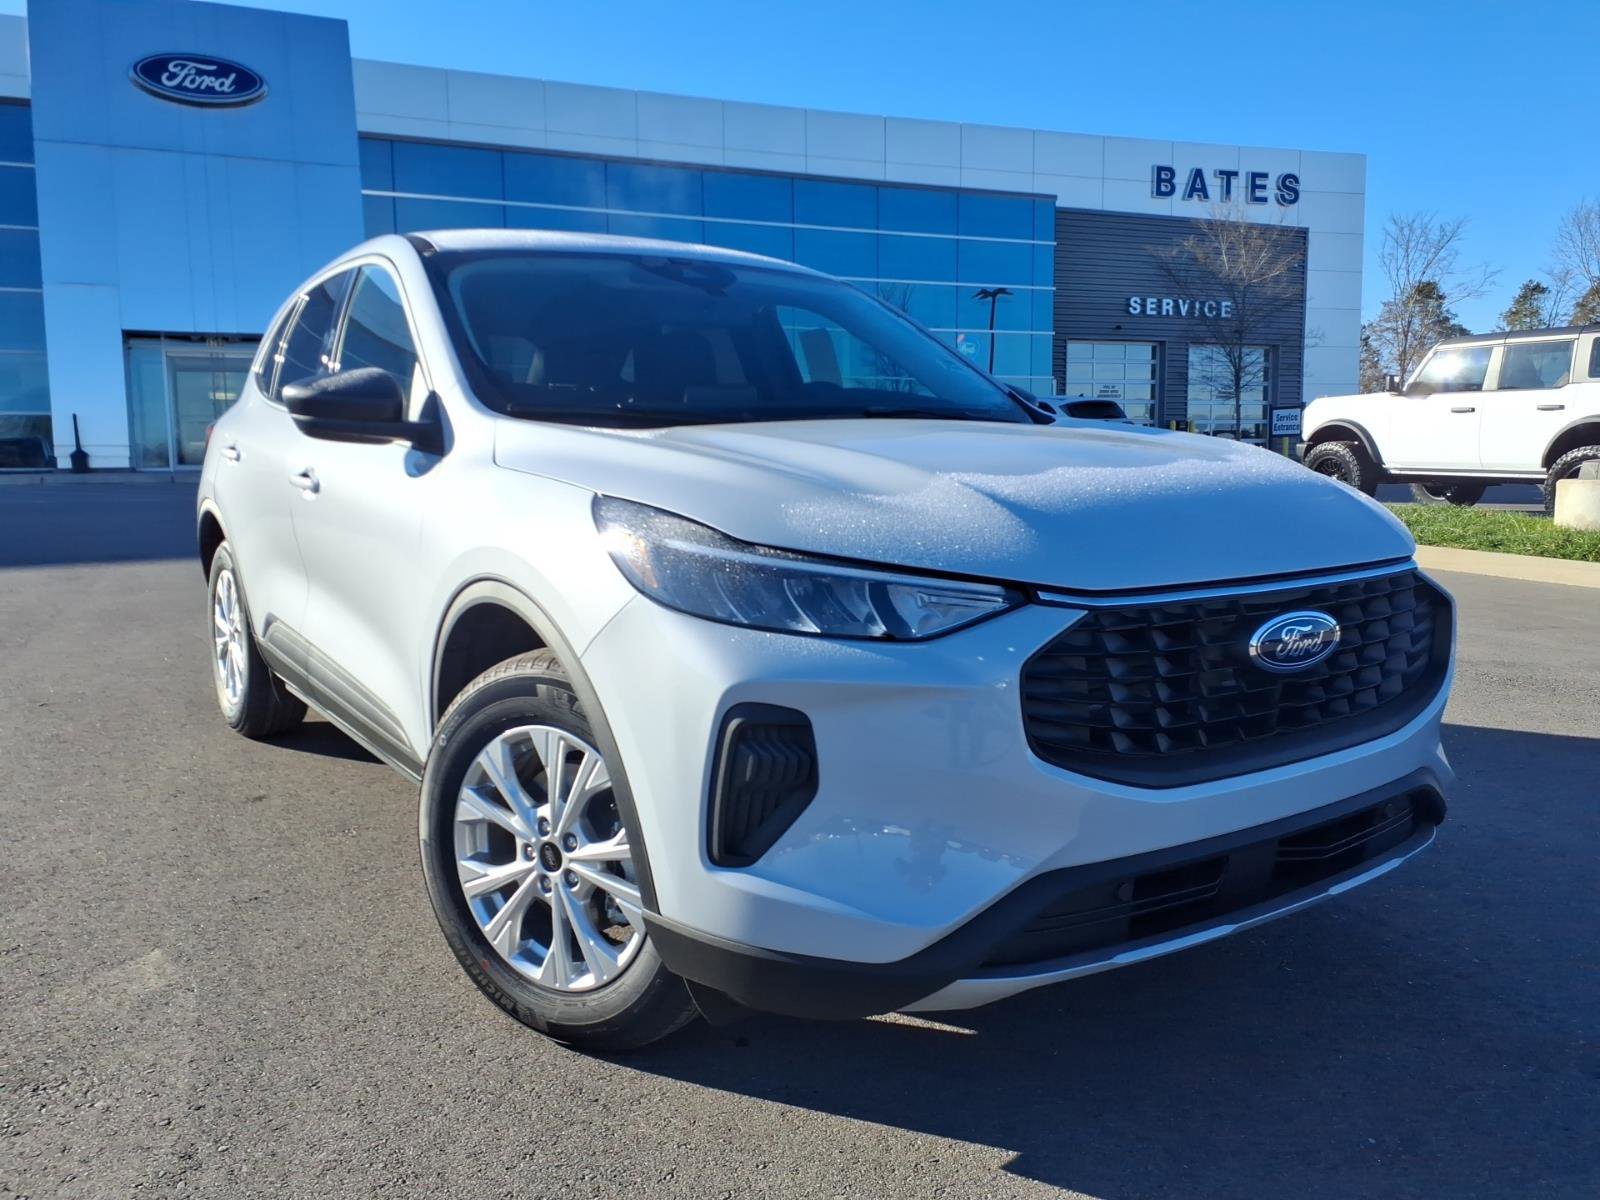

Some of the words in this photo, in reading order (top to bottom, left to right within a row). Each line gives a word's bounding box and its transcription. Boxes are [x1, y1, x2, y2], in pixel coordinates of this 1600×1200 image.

[161, 60, 236, 92] Ford
[1151, 165, 1300, 207] BATES
[1128, 296, 1232, 318] SERVICE
[1273, 423, 1300, 431] Entrance
[1276, 413, 1298, 422] Service
[1276, 624, 1324, 659] Ford
